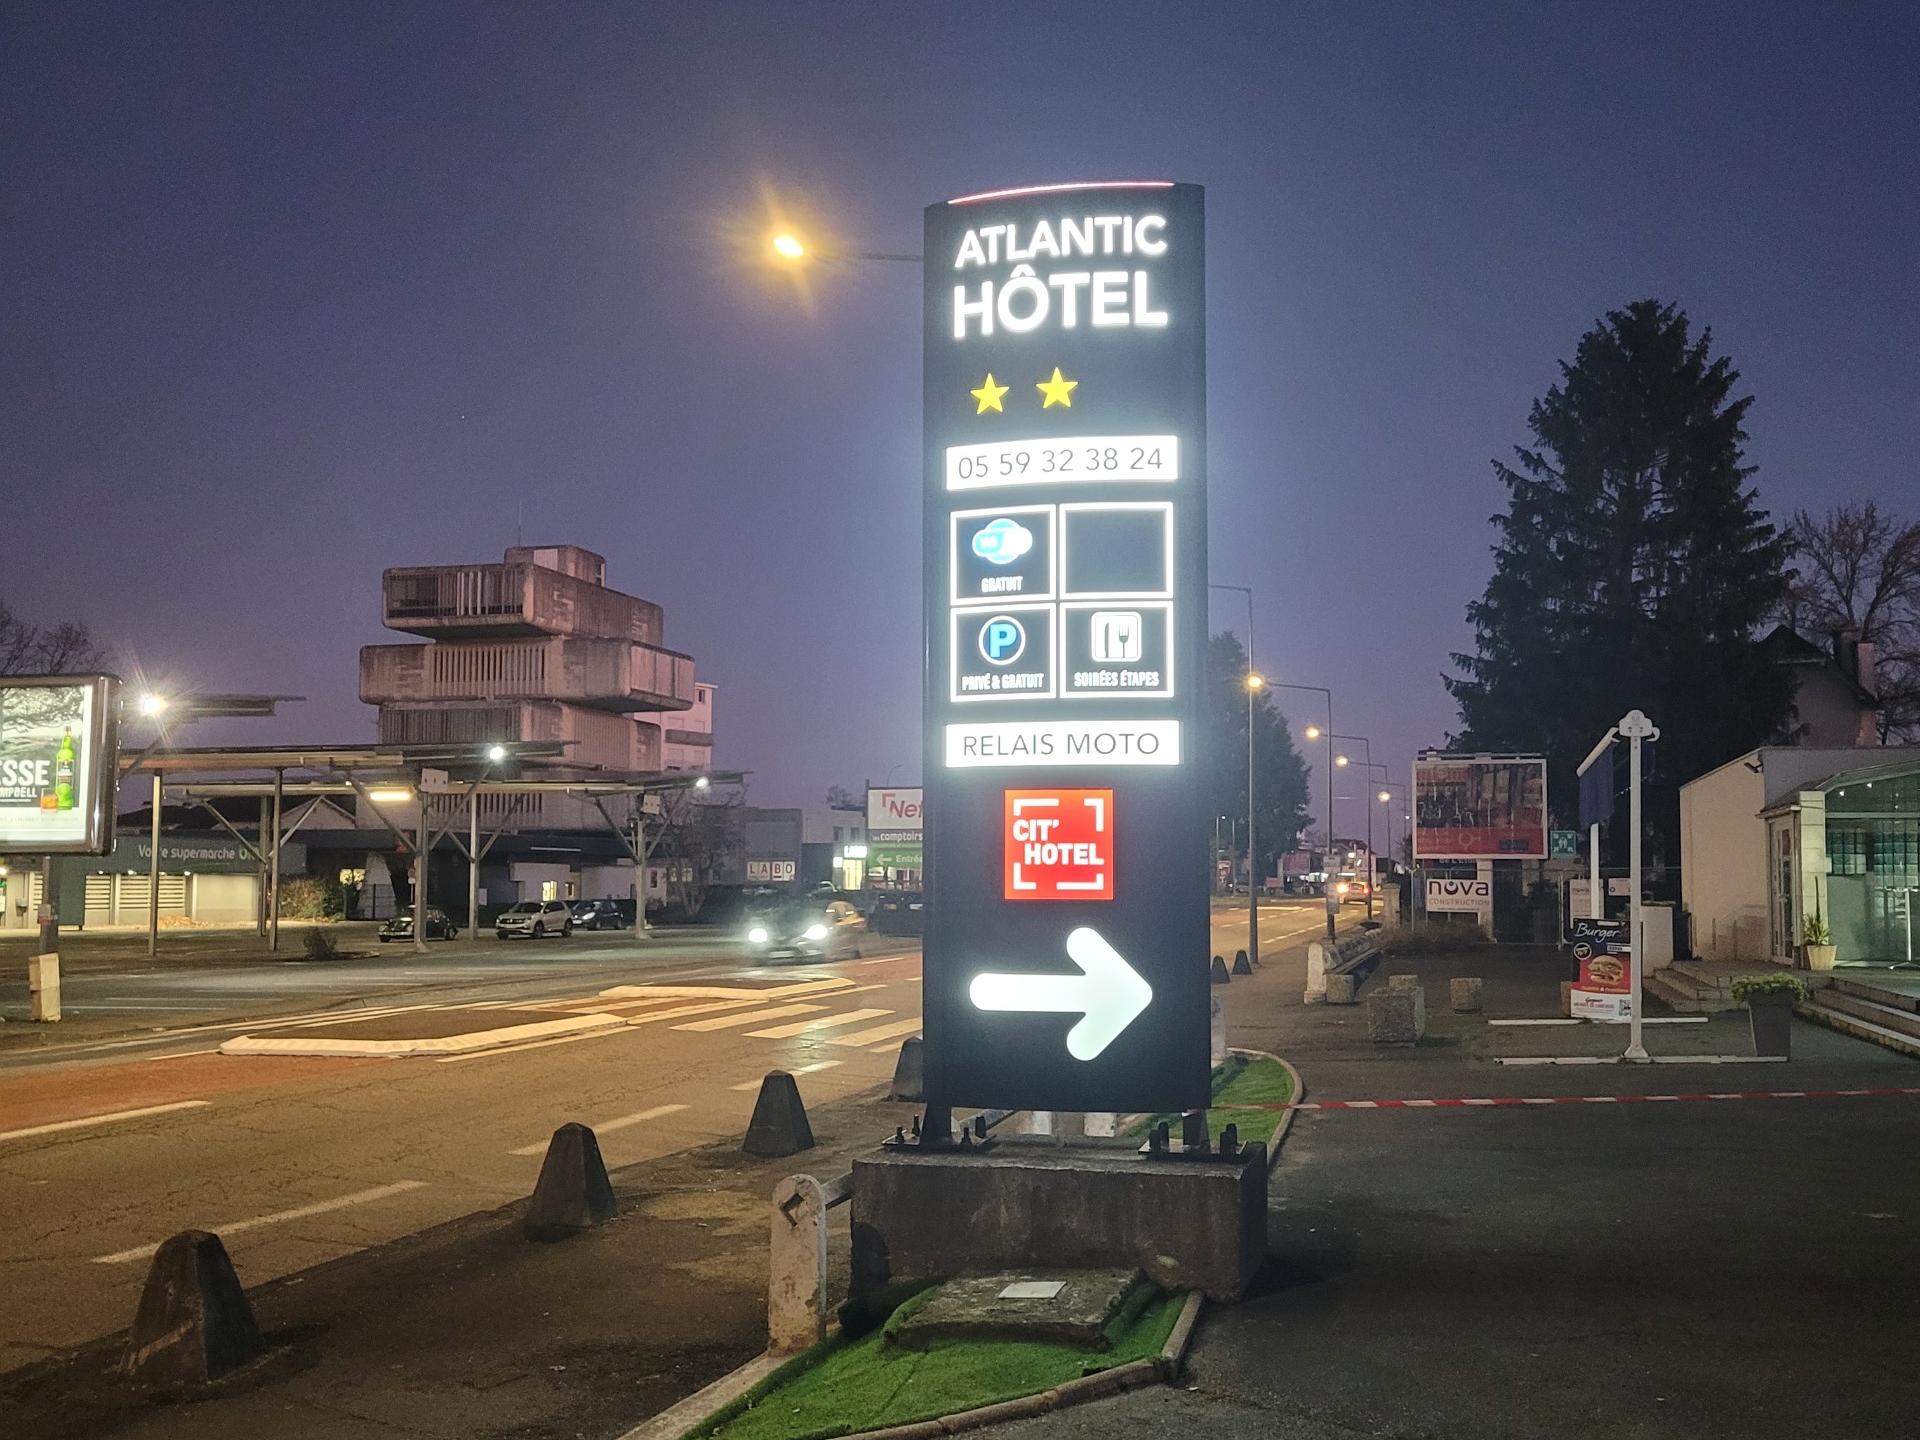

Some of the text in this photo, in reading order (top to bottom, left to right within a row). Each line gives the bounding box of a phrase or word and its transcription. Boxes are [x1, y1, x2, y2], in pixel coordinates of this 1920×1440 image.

[955, 214, 1169, 270] ATLANTIC
[953, 265, 1169, 339] HÔTEL
[958, 446, 1162, 479] 05 59 32 38 24
[981, 576, 1023, 593] GRATUIT
[990, 623, 1017, 658] P
[961, 673, 1044, 690] PRIVÉ & GRATUIT
[1073, 670, 1160, 687] SOIRÉES ÉTAPES
[963, 732, 1160, 757] RELAIS MOTO
[0, 759, 51, 786] SSE
[138, 844, 168, 858] Voe
[1025, 842, 1105, 866] HOTEL
[749, 863, 793, 874] LABO
[1428, 881, 1489, 897] nova
[1574, 922, 1620, 944] Burger
